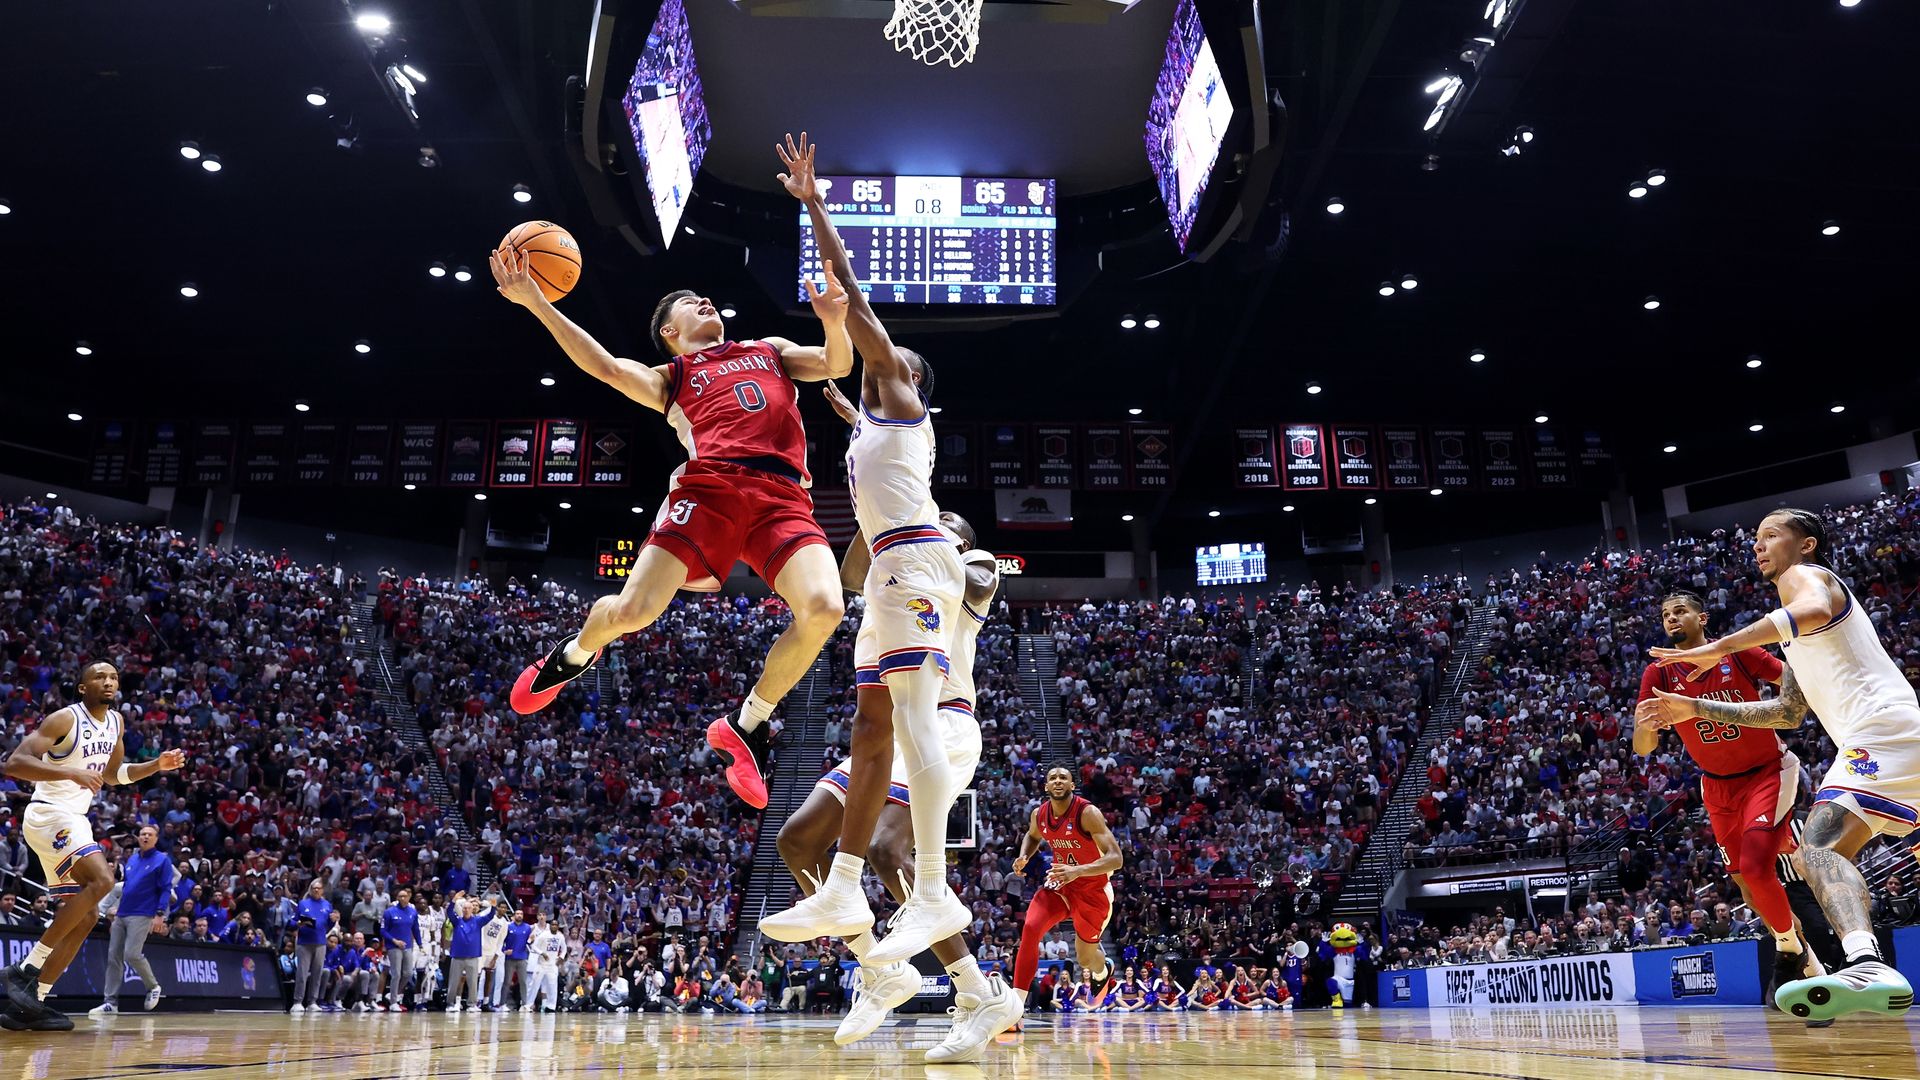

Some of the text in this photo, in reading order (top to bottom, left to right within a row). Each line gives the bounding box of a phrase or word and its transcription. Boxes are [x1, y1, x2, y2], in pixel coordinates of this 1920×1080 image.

[853, 180, 881, 201] 65
[976, 182, 1005, 204] 65
[843, 203, 857, 212] FLS
[915, 198, 941, 214] 0.8
[962, 205, 987, 214] BONUS
[1003, 206, 1016, 214] FLS
[1015, 230, 1020, 238] 1
[1028, 230, 1035, 238] 4
[1029, 240, 1034, 250] 1
[900, 250, 907, 259] 4
[914, 250, 920, 259] 1
[1015, 263, 1021, 272] 7
[1029, 263, 1034, 272] 1
[900, 273, 906, 281] 1
[894, 292, 905, 302] 71
[690, 354, 782, 397] ST. JOHN'S
[733, 380, 767, 413] 0
[403, 438, 434, 448] WAC
[499, 473, 526, 482] 2006
[547, 472, 574, 482] 2006
[594, 472, 622, 482] 2009
[943, 475, 968, 484] 2014
[994, 476, 1018, 484] 2014
[1044, 476, 1069, 484] 2015
[1244, 474, 1268, 483] 2018
[1293, 476, 1318, 485] 2020
[1346, 476, 1369, 484] 2021
[1394, 476, 1417, 484] 2021
[1444, 477, 1468, 485] 2023
[1491, 477, 1515, 485] 2023
[617, 540, 633, 551] 0.7
[600, 554, 613, 565] 65
[598, 567, 605, 575] 6
[1052, 838, 1081, 849] JOHN'S
[1678, 957, 1702, 975] MARCH
[175, 958, 219, 984] KANSAS
[1446, 960, 1614, 1004] FIRST AND SECOND ROUNDS
[1682, 973, 1717, 990] MADNESS
